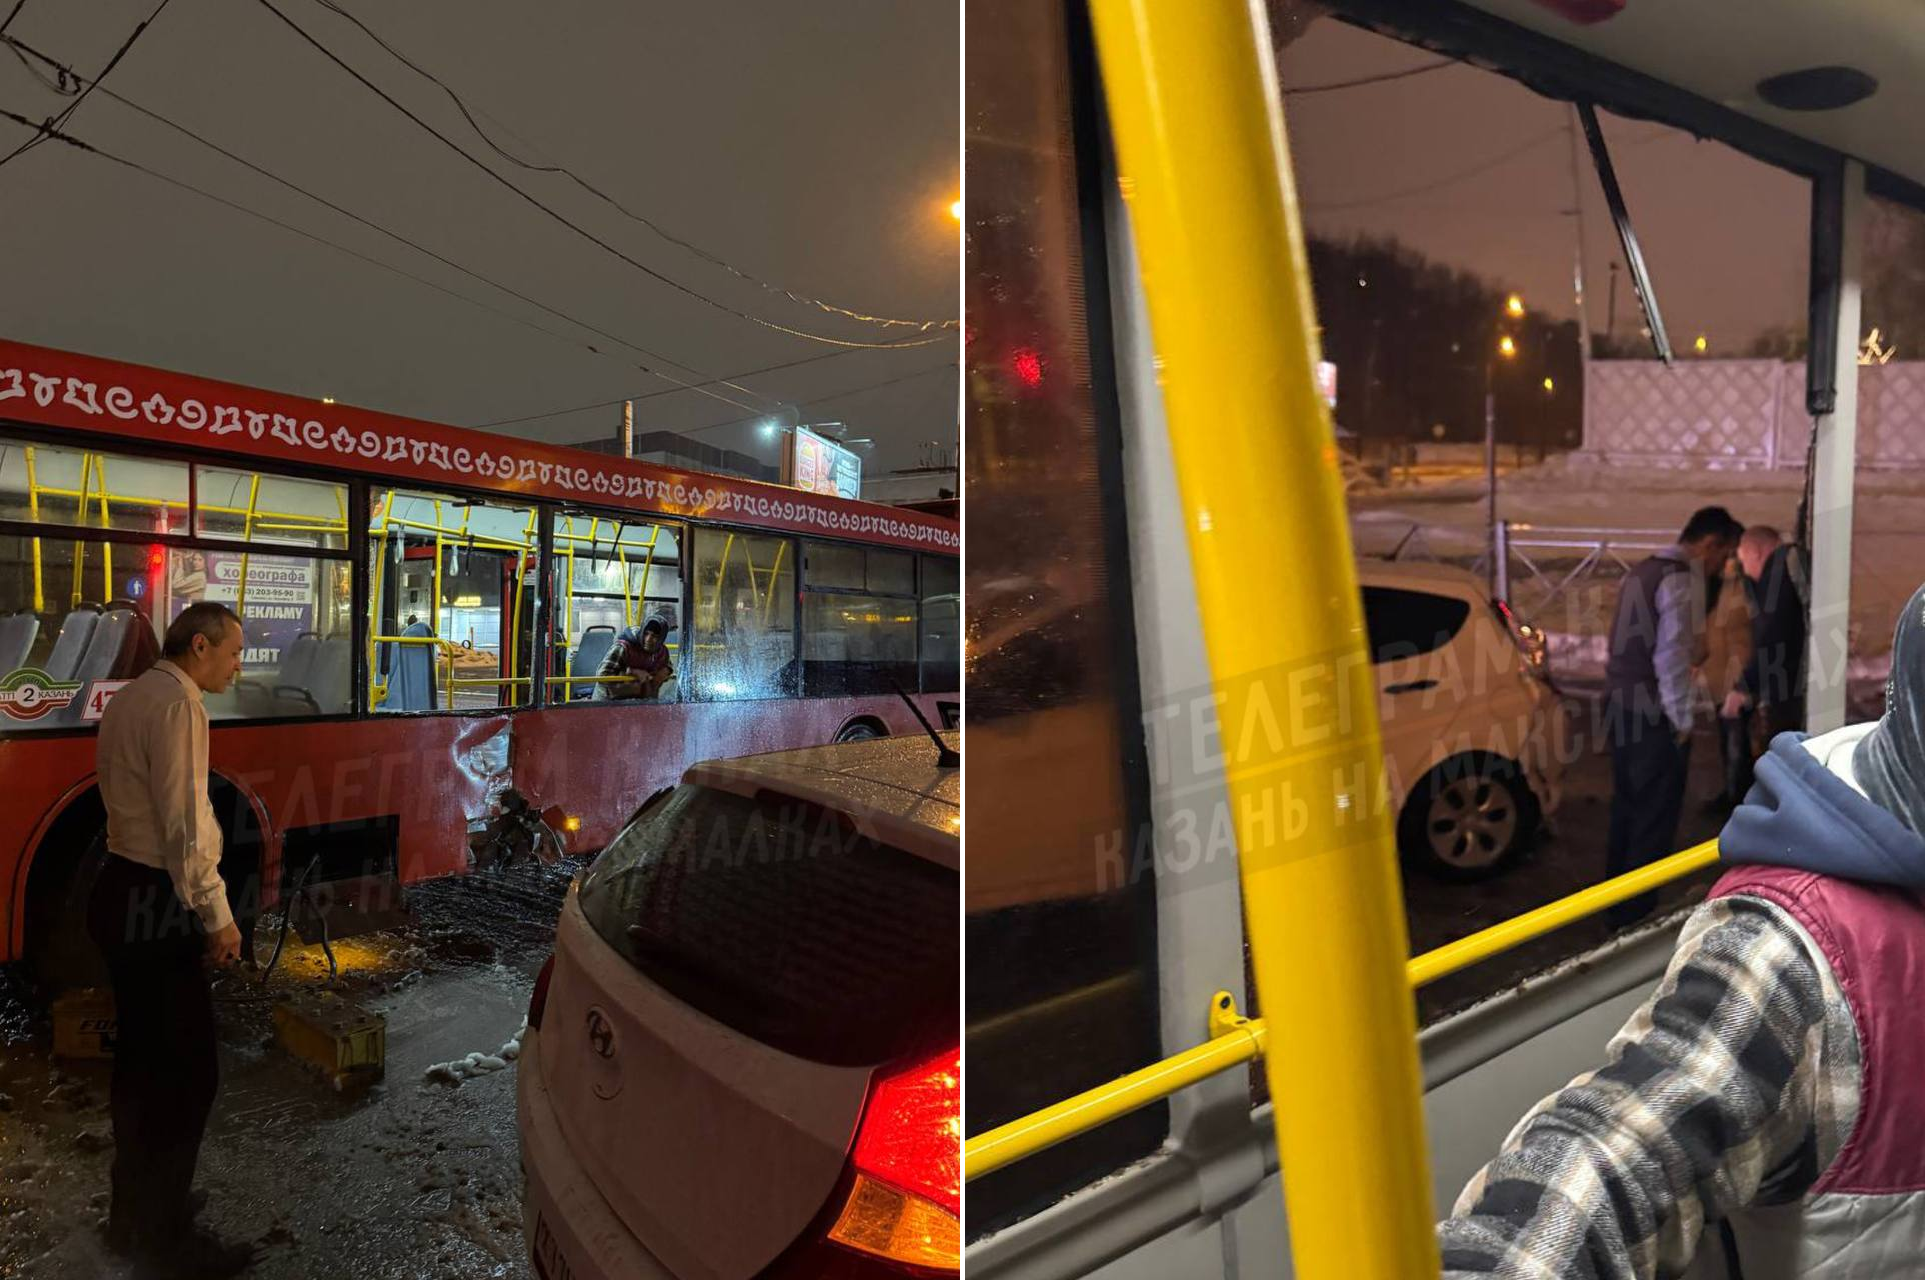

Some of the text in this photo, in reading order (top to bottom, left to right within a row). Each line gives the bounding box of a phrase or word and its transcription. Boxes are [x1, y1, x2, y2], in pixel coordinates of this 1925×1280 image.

[223, 567, 306, 584] хоеографа
[23, 687, 35, 702] 2
[38, 689, 75, 699] КАЗАНЬ
